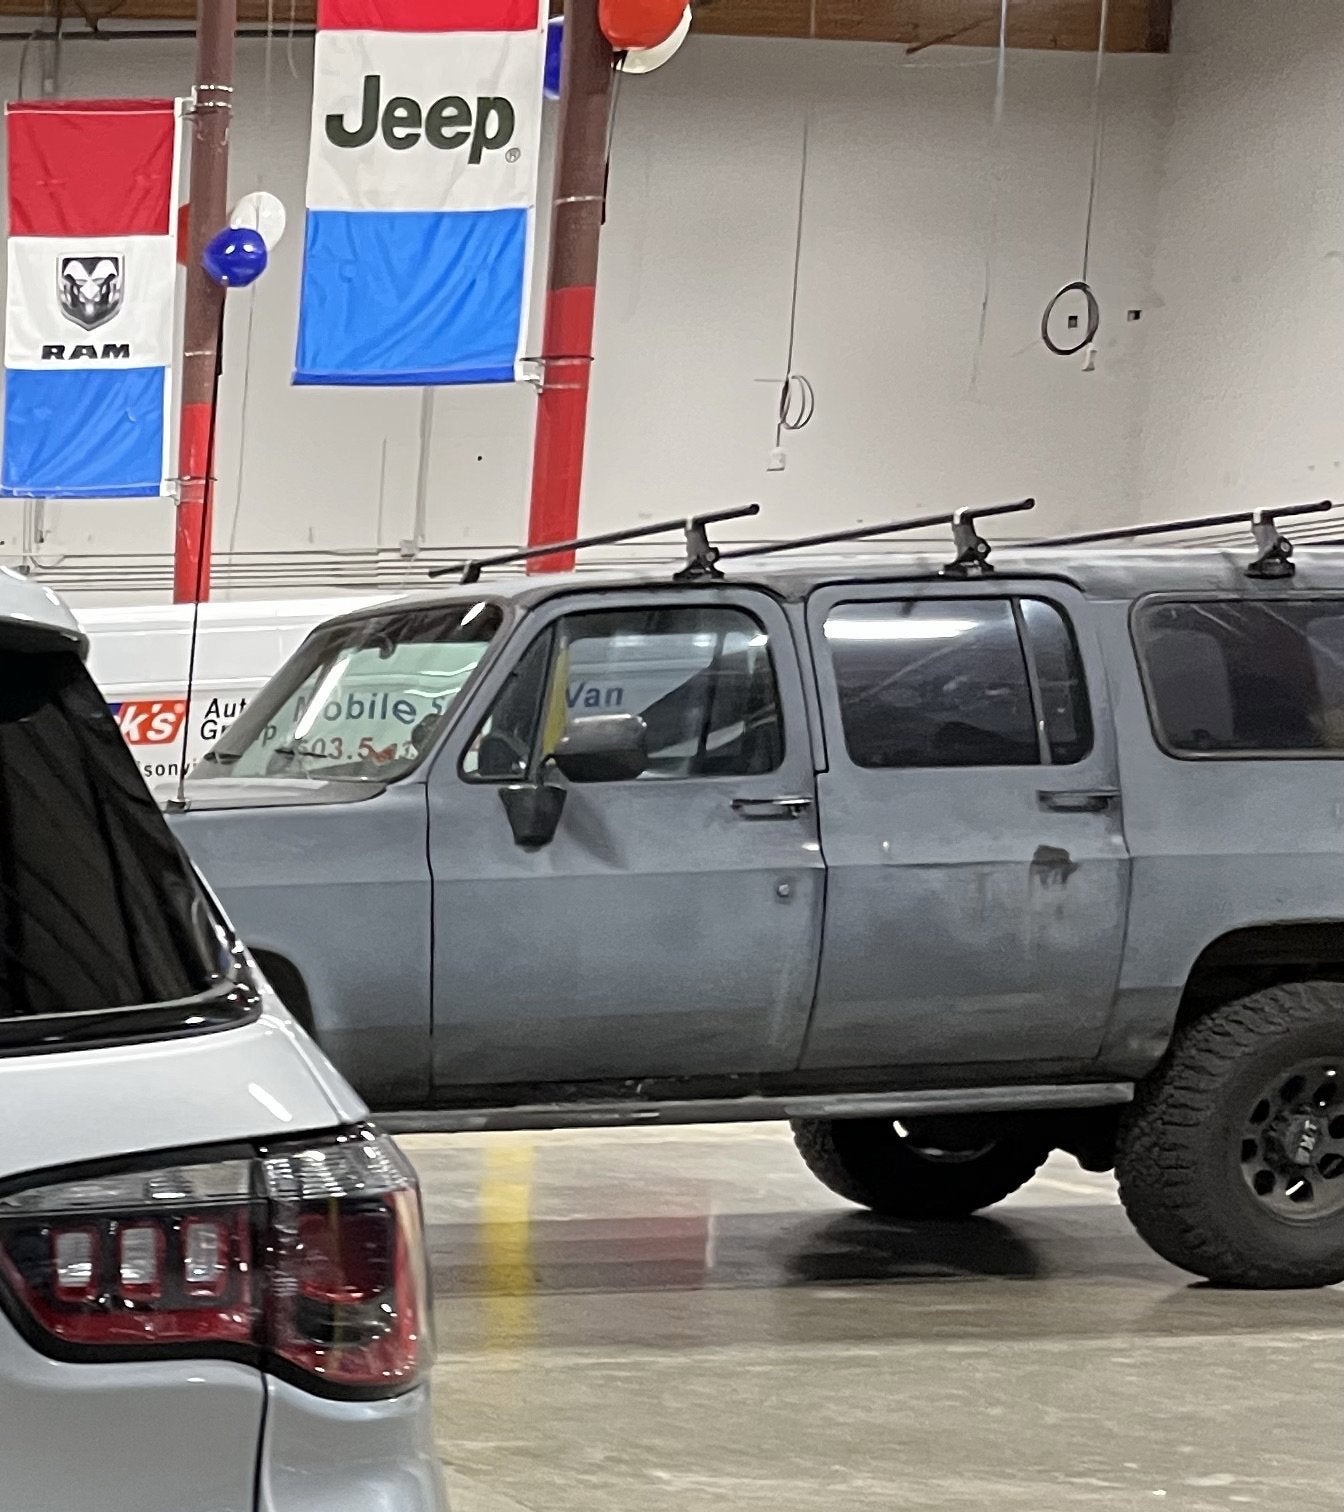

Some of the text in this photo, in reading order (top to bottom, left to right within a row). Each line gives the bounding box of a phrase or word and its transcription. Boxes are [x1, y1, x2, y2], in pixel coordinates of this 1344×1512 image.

[324, 74, 516, 165] Jeep
[41, 343, 130, 361] RAM
[565, 681, 624, 708] Van
[205, 698, 247, 719] Aut
